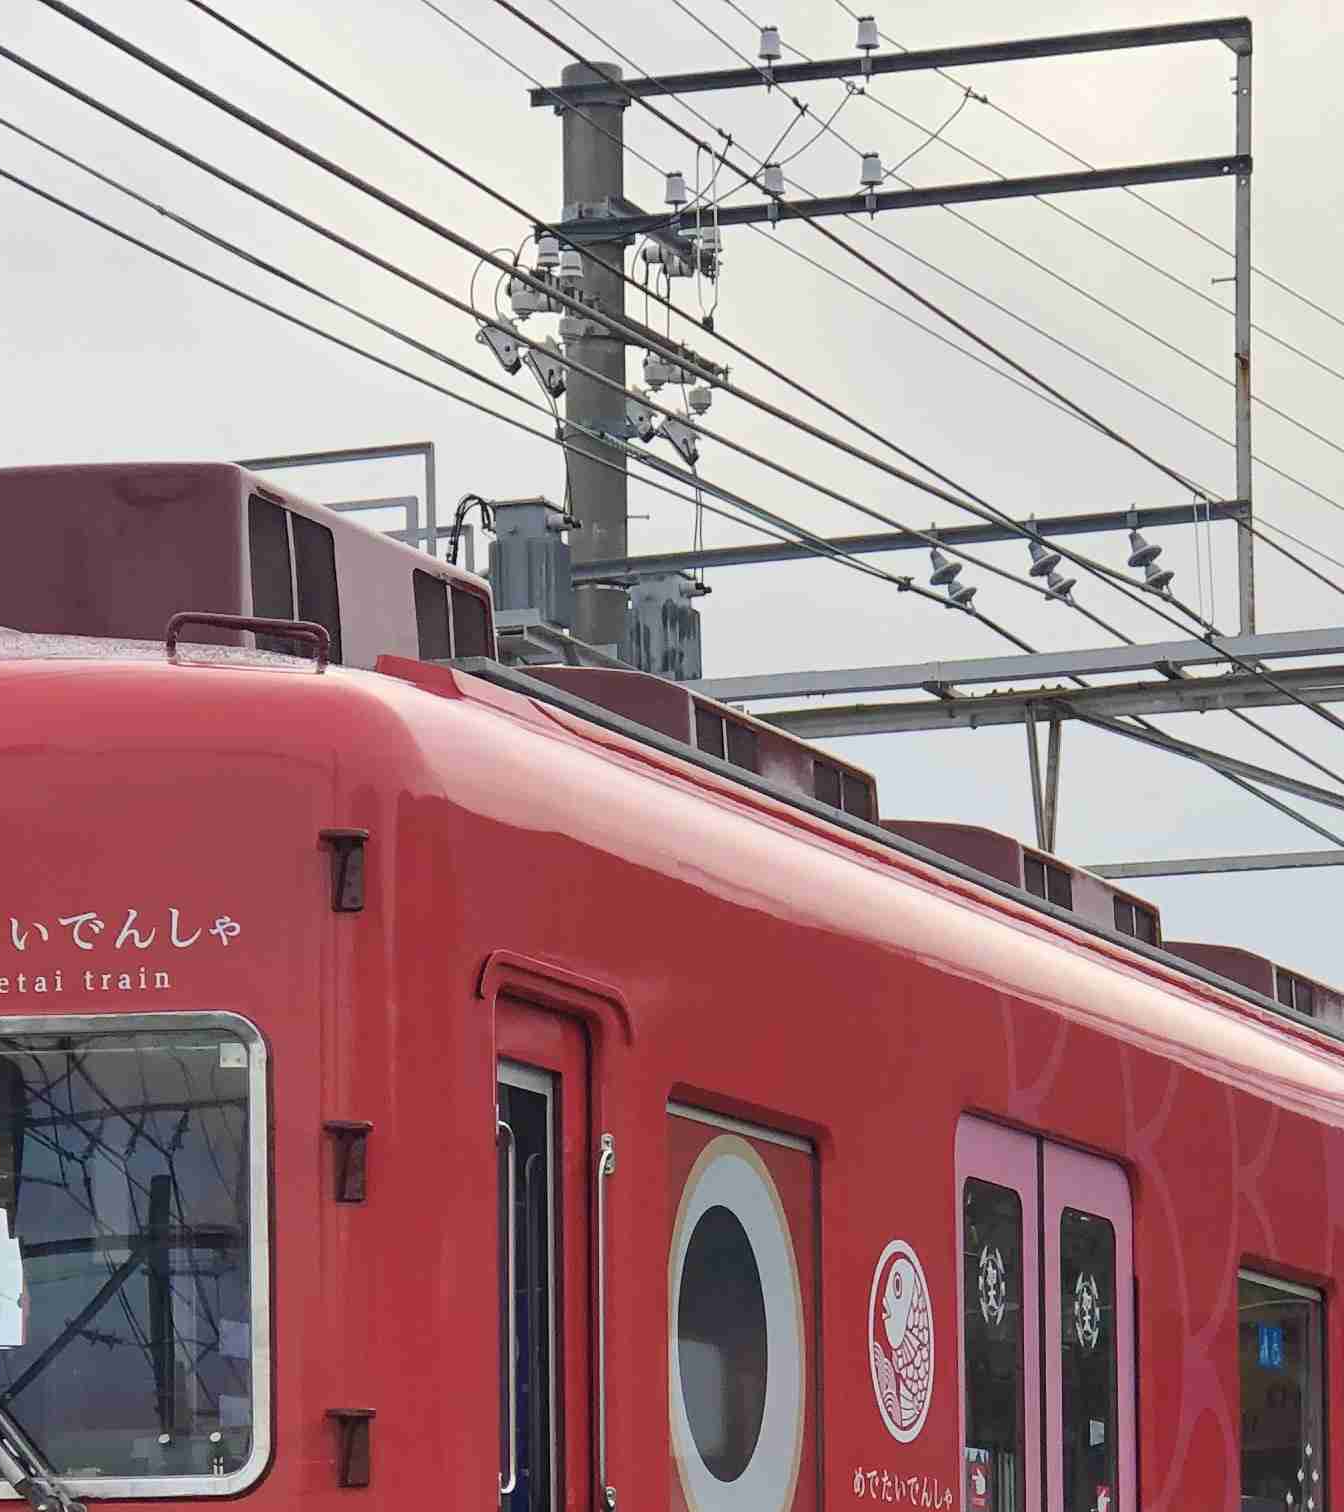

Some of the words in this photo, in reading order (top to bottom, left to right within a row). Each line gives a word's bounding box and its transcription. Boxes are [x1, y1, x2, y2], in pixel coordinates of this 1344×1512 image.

[84, 966, 171, 992] train
[853, 1466, 953, 1511] めでたいでんしゃ
